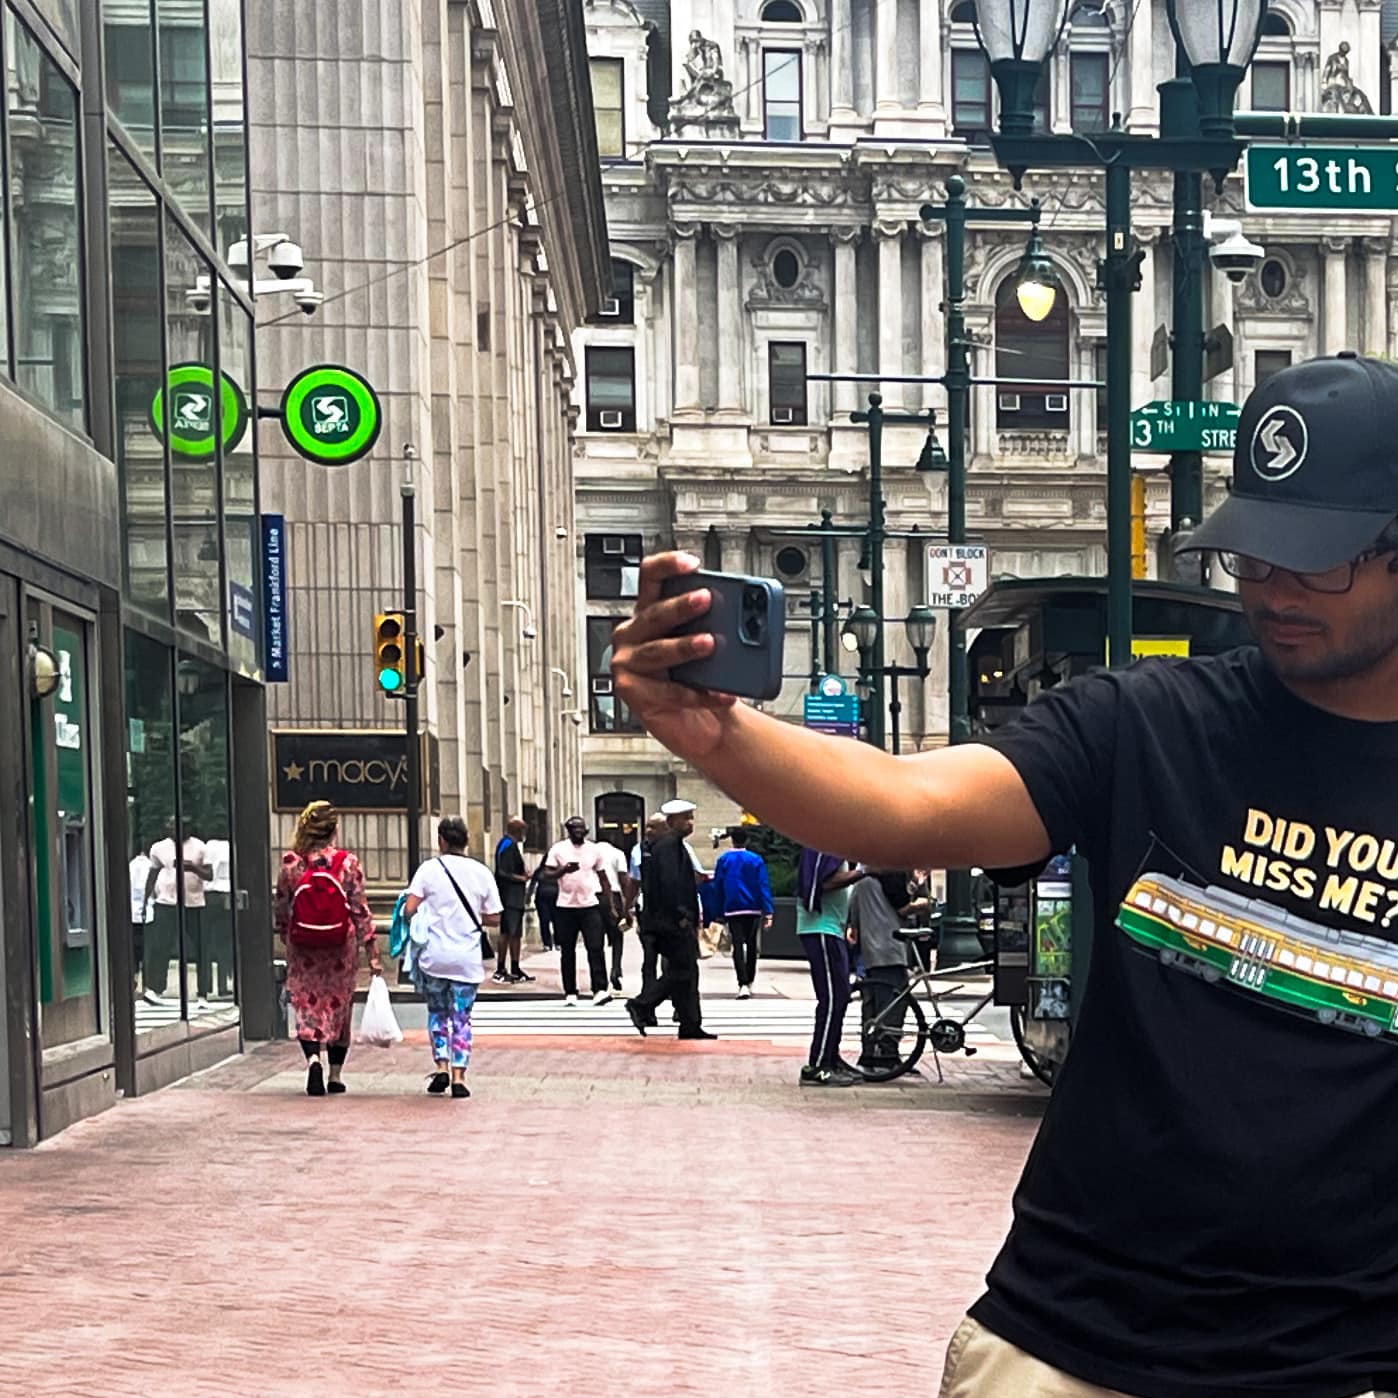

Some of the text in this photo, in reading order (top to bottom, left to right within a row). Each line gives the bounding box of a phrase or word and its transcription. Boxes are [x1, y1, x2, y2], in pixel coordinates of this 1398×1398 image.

[1273, 156, 1371, 193] 13th
[314, 422, 349, 434] SEPTA
[1201, 429, 1237, 448] STRE
[956, 548, 985, 559] BLOCK
[268, 528, 282, 658] Market Frankford Line
[932, 593, 980, 606] THE BO
[1244, 808, 1316, 860] DID
[1220, 845, 1317, 898] MISS
